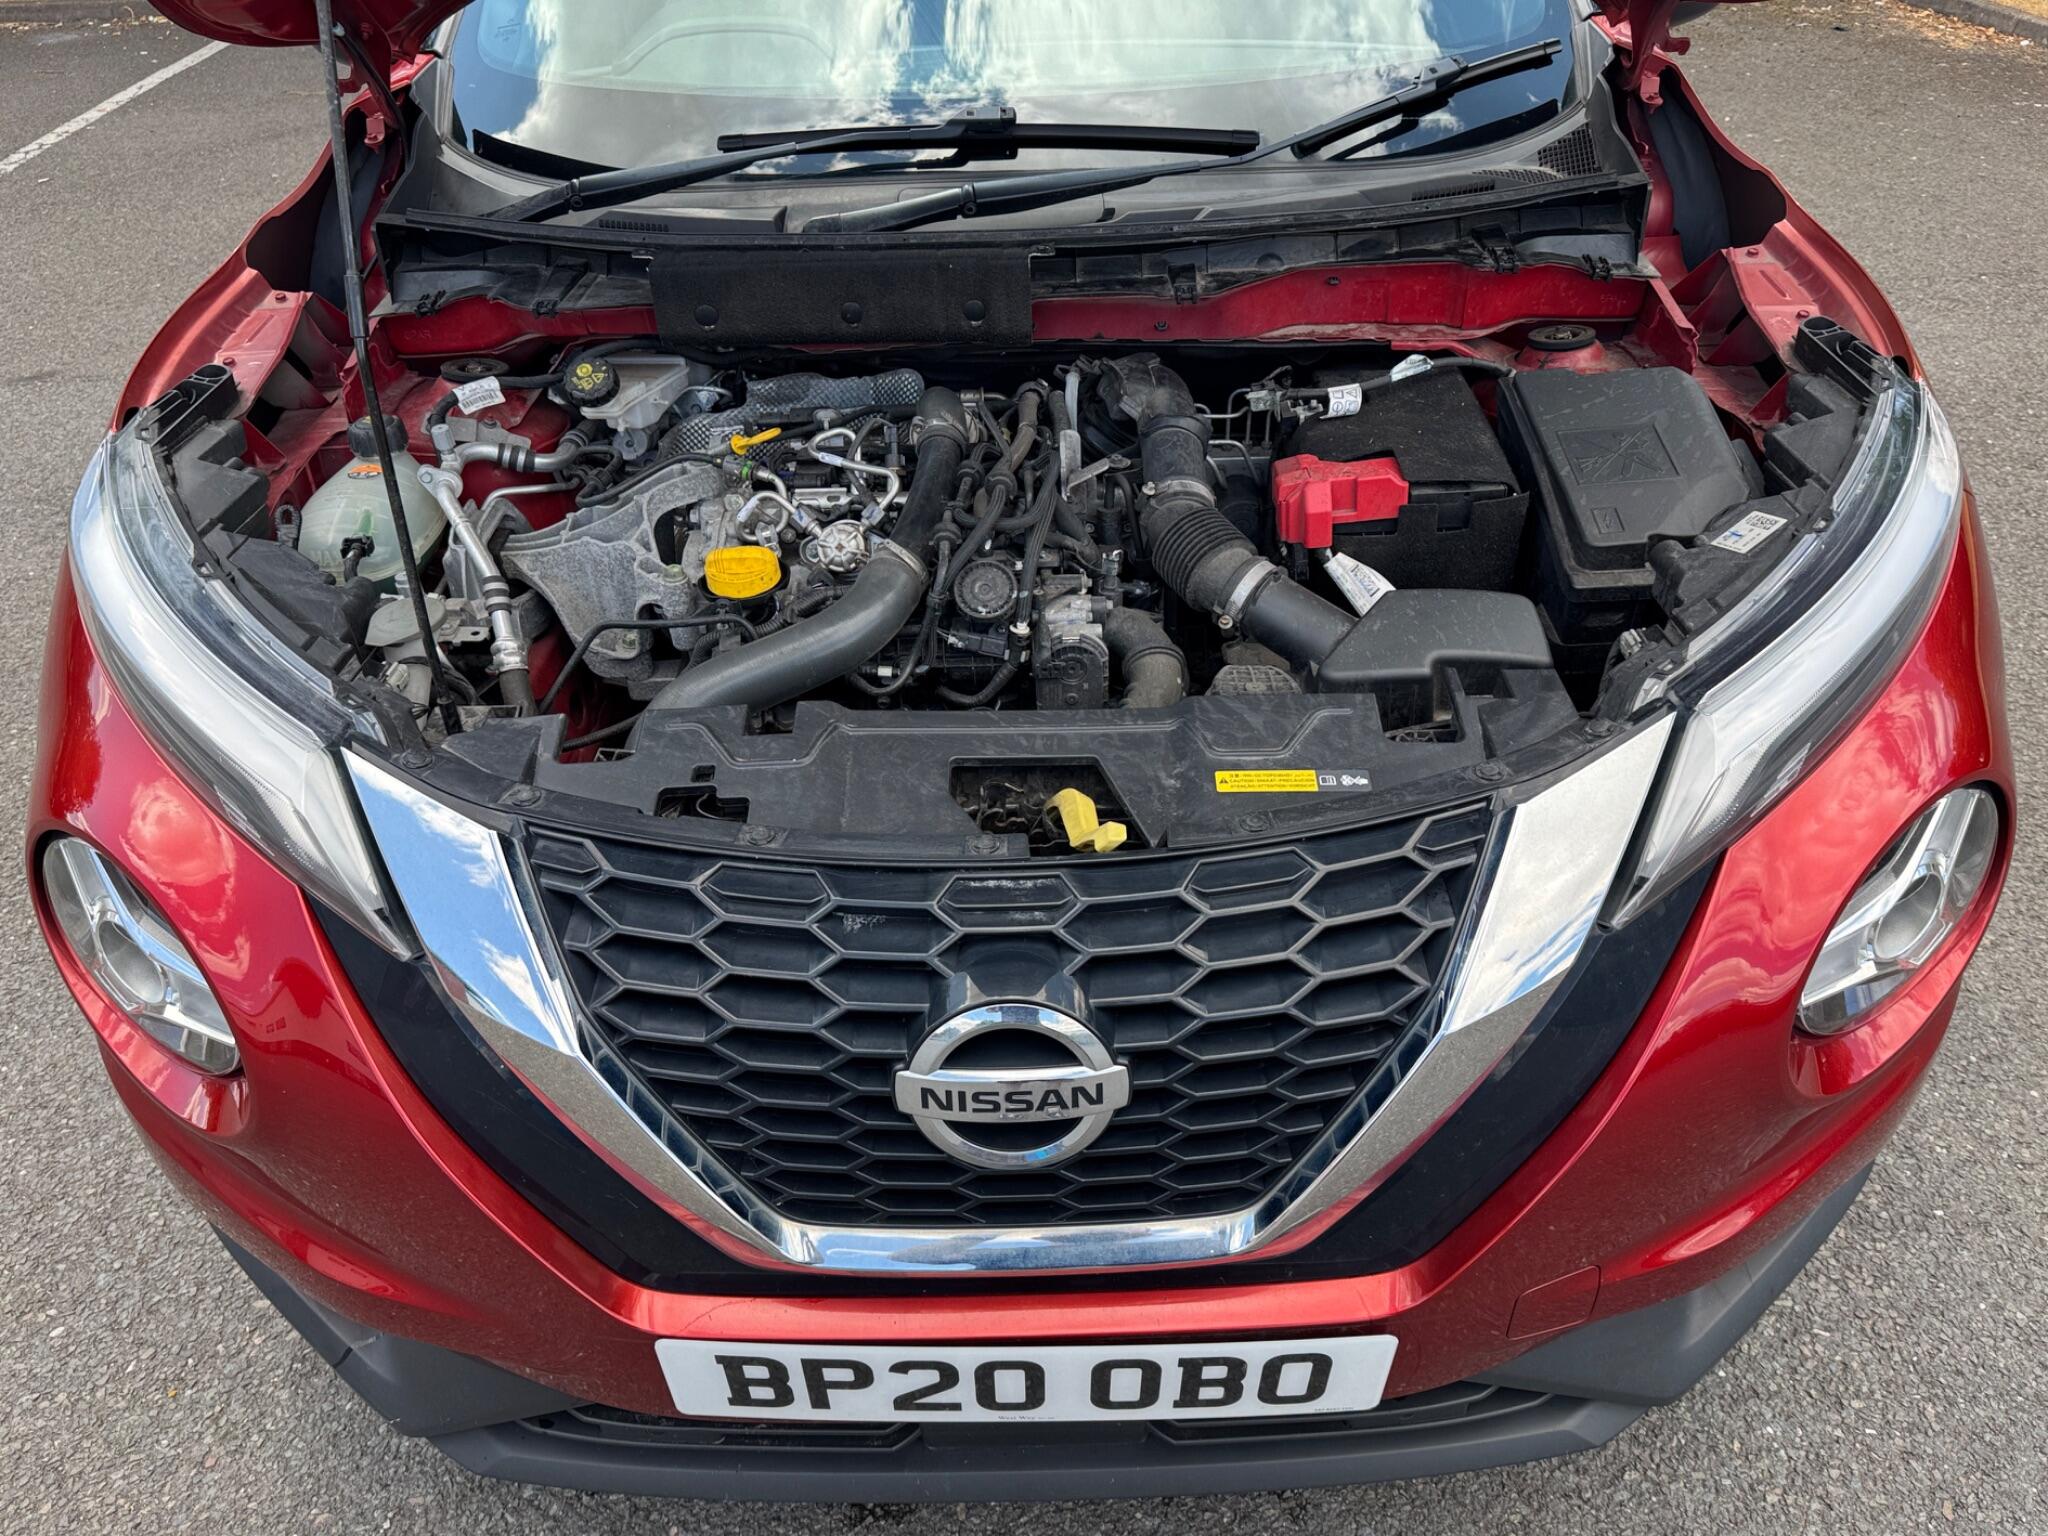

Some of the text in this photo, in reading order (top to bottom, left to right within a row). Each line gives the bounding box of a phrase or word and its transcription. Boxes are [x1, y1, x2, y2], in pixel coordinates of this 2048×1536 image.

[920, 1082, 1104, 1113] NISSAN
[714, 1353, 1333, 1411] BP20 OBO
